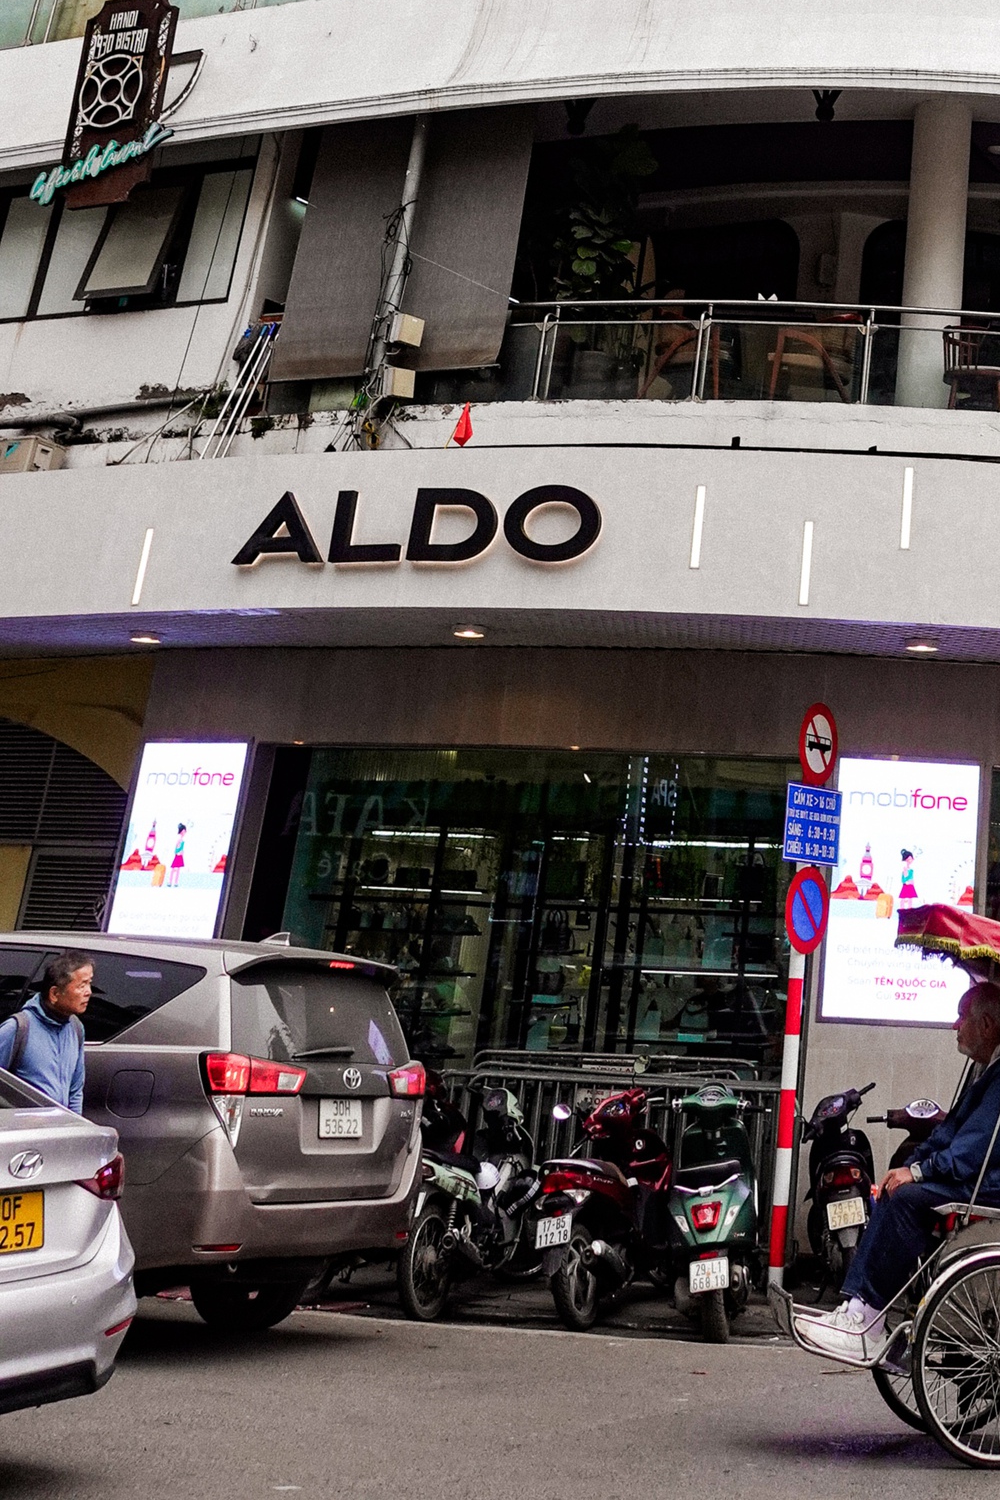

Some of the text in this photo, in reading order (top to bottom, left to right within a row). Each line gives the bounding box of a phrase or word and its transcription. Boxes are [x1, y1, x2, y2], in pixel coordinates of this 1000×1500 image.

[115, 28, 149, 54] BISTRO
[231, 484, 602, 566] ALDO
[147, 767, 235, 786] mobifone
[849, 788, 968, 811] mobifone
[874, 976, 894, 986] TÊN
[896, 976, 927, 988] QUỐC
[929, 980, 947, 989] GIA
[894, 991, 918, 1001] 9327
[333, 1101, 350, 1116] 30H
[325, 1119, 359, 1135] 536.22
[542, 1217, 567, 1231] 17-B5
[538, 1229, 569, 1244] 112.18
[695, 1261, 722, 1277] 29-L1
[692, 1275, 726, 1291] 668.18
